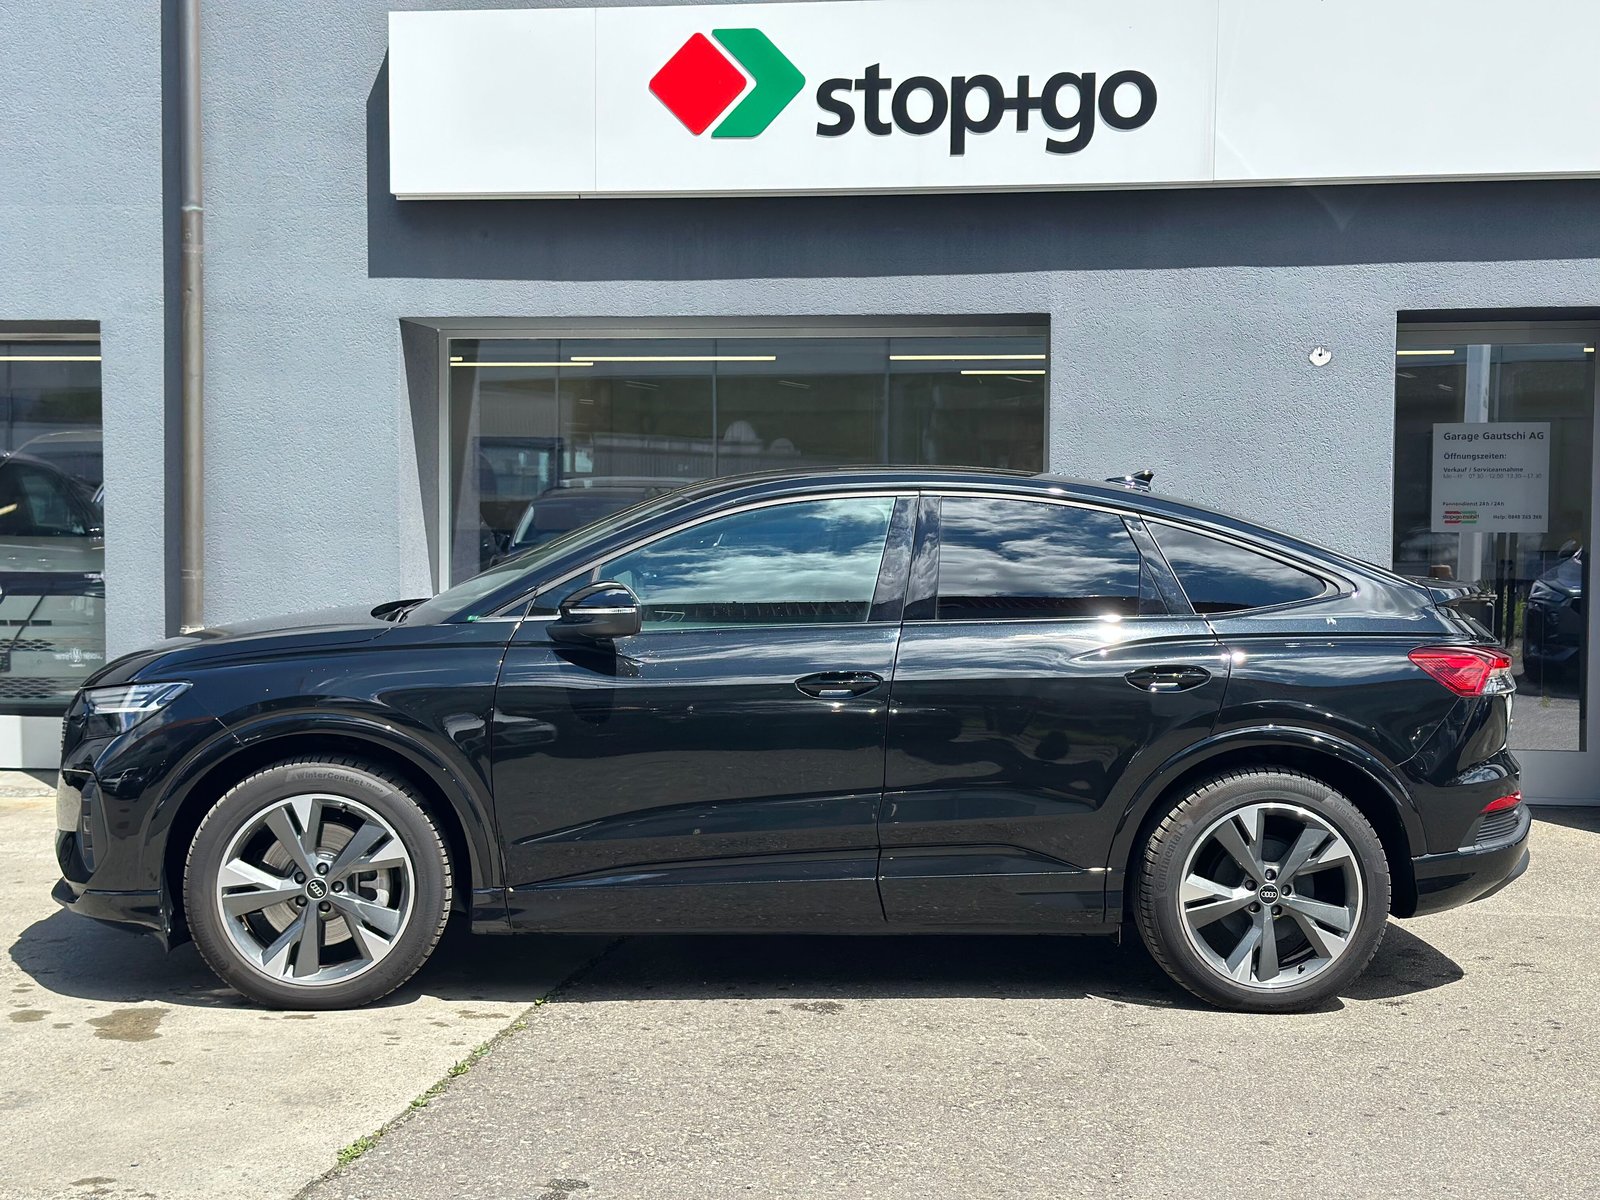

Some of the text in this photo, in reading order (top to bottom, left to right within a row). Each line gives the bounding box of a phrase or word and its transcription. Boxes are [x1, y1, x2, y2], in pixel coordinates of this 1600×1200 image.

[816, 63, 1158, 156] stop+go
[1443, 431, 1544, 442] Garage Gautschi AG
[1443, 452, 1507, 461] Öffnungszeiten:
[296, 771, 364, 787] WinterContact
